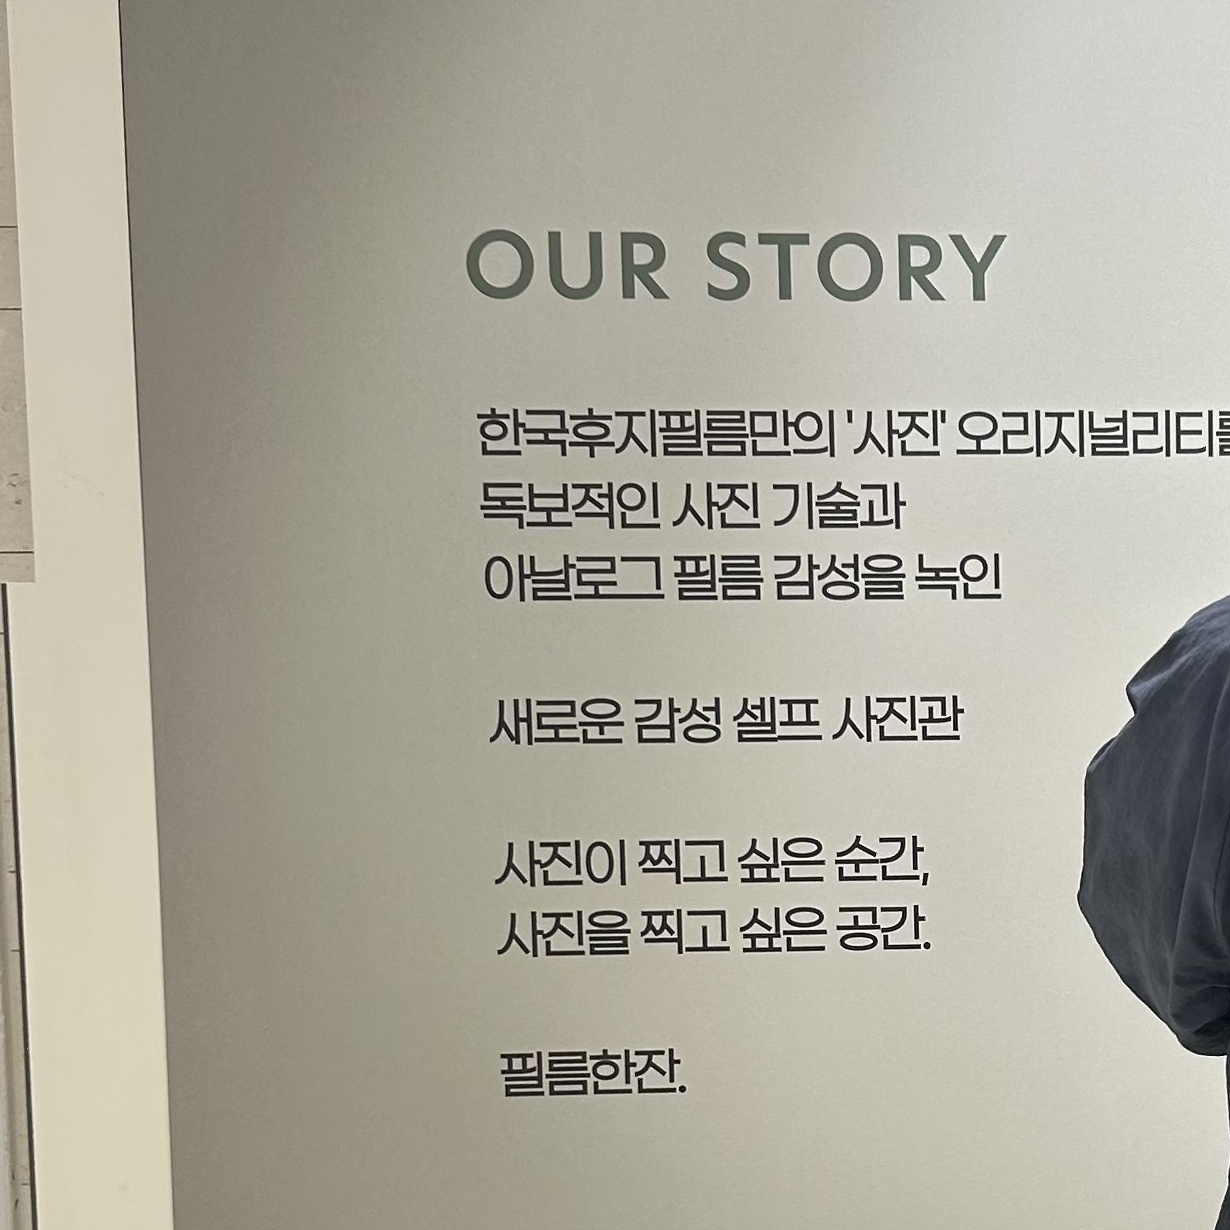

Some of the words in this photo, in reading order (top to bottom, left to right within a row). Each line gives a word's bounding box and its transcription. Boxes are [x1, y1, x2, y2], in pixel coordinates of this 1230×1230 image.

[465, 229, 671, 301] OUR
[706, 230, 1007, 302] STORY
[476, 407, 836, 459] 한국후지필름만의
[479, 481, 661, 530] 독보적인
[672, 481, 761, 530] 사진
[772, 480, 907, 530] 기술과
[484, 554, 665, 603] 아날로그
[673, 553, 764, 601] 필름
[773, 553, 907, 601] 감성을
[914, 552, 1002, 601] 녹인
[489, 697, 625, 746] 새로운
[634, 696, 722, 744] 감성
[732, 696, 823, 743] 셀프
[831, 694, 965, 743] 사진관
[494, 839, 627, 888] 사진이
[638, 838, 729, 885] 찍고
[737, 837, 826, 884] 싶은
[834, 835, 929, 886] 순간,
[497, 910, 632, 958] 사진을
[640, 908, 731, 955] 찍고
[739, 906, 828, 954] 싶은
[836, 904, 931, 952] 공간.
[500, 1048, 687, 1098] 필름한잔.
